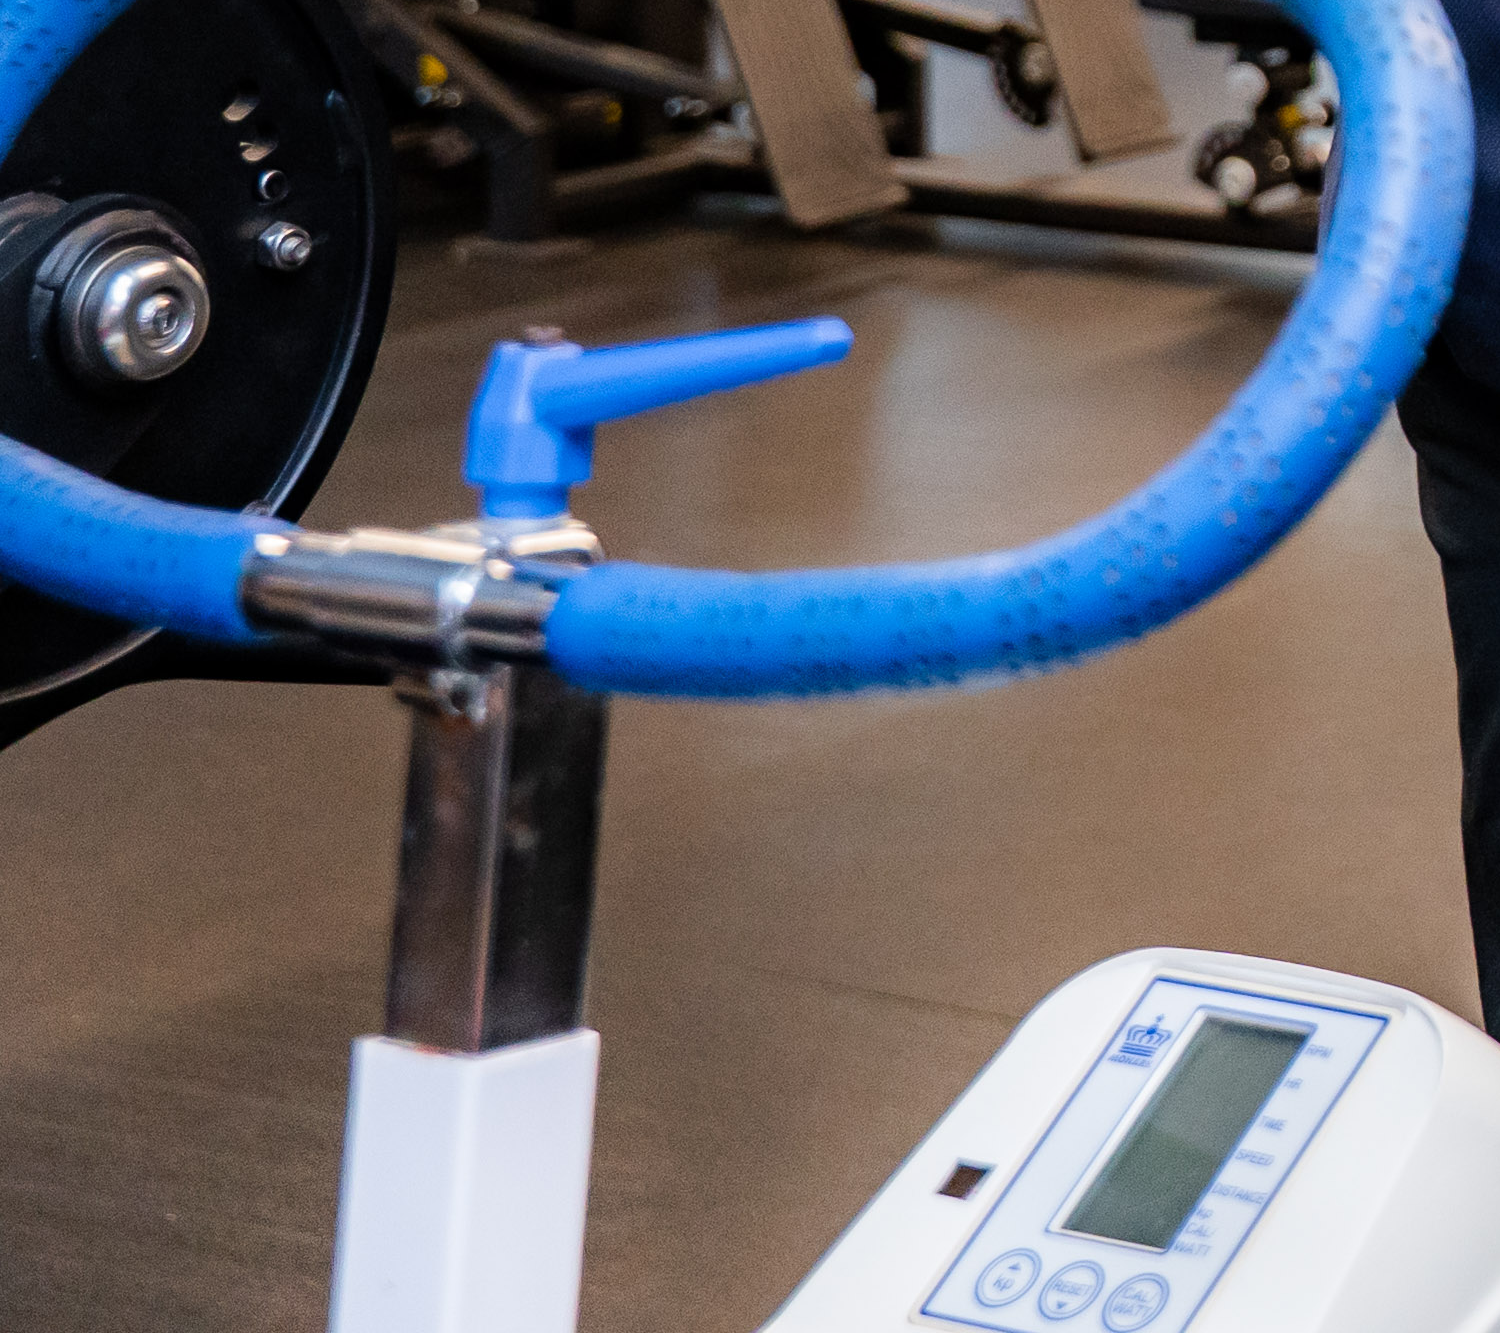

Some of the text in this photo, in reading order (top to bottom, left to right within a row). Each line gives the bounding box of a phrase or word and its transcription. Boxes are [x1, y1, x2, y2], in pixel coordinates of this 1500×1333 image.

[1234, 1148, 1275, 1166] SPEED
[1210, 1183, 1269, 1205] DISTANCE
[1173, 1241, 1212, 1255] WATT
[1052, 1278, 1094, 1297] RESET
[1111, 1302, 1153, 1318] WATT
